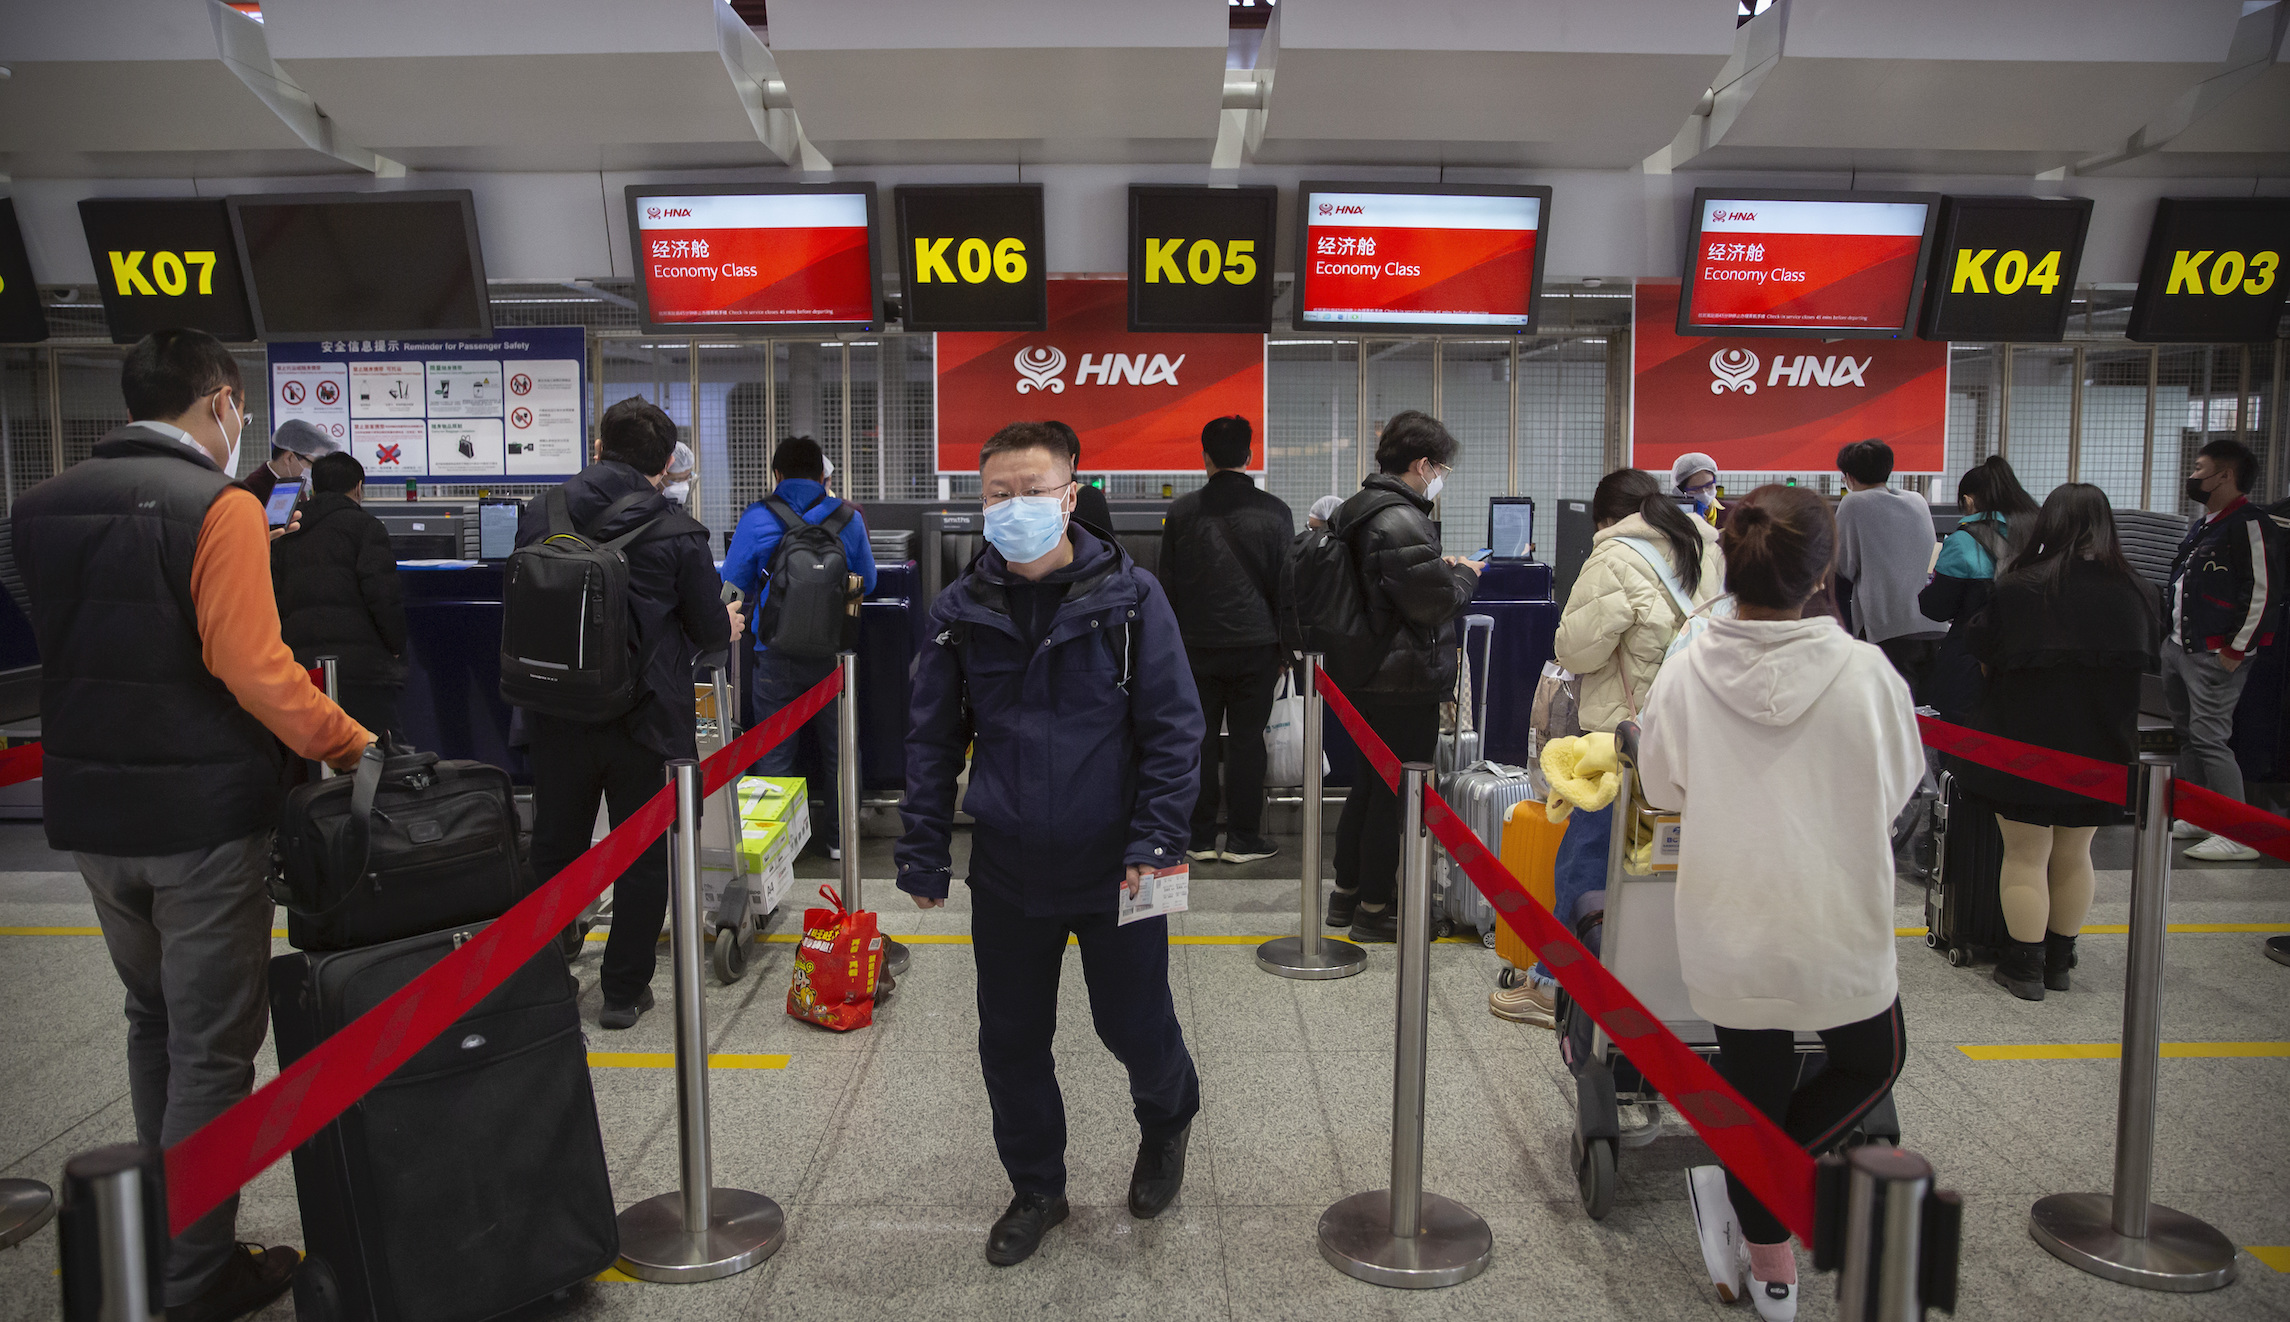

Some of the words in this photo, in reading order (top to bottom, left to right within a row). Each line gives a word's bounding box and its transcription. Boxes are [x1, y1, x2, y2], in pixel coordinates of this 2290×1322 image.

[664, 208, 692, 217] HNA
[1335, 205, 1366, 215] HNA
[1728, 212, 1758, 221] HNA
[652, 239, 710, 259] 经济舱
[1317, 236, 1377, 257] 经济舱
[1706, 243, 1766, 263] 经济舱
[915, 237, 1028, 284] K06
[1145, 237, 1257, 285] K05
[1316, 261, 1382, 280] Economy
[1384, 261, 1421, 277] Class
[108, 250, 216, 296] K07
[654, 264, 719, 282] Economy
[721, 263, 758, 278] Class
[1704, 266, 1768, 286] Economy
[1770, 267, 1806, 283] Class
[1951, 248, 2062, 294] K04
[2165, 250, 2279, 296] K03
[321, 340, 400, 353] 安全信息提示
[403, 342, 443, 351] Reminder
[445, 342, 457, 351] for
[458, 342, 502, 353] Passenger
[503, 341, 530, 352] Safety
[1075, 352, 1187, 386] HNA
[1766, 355, 1873, 387] HNA
